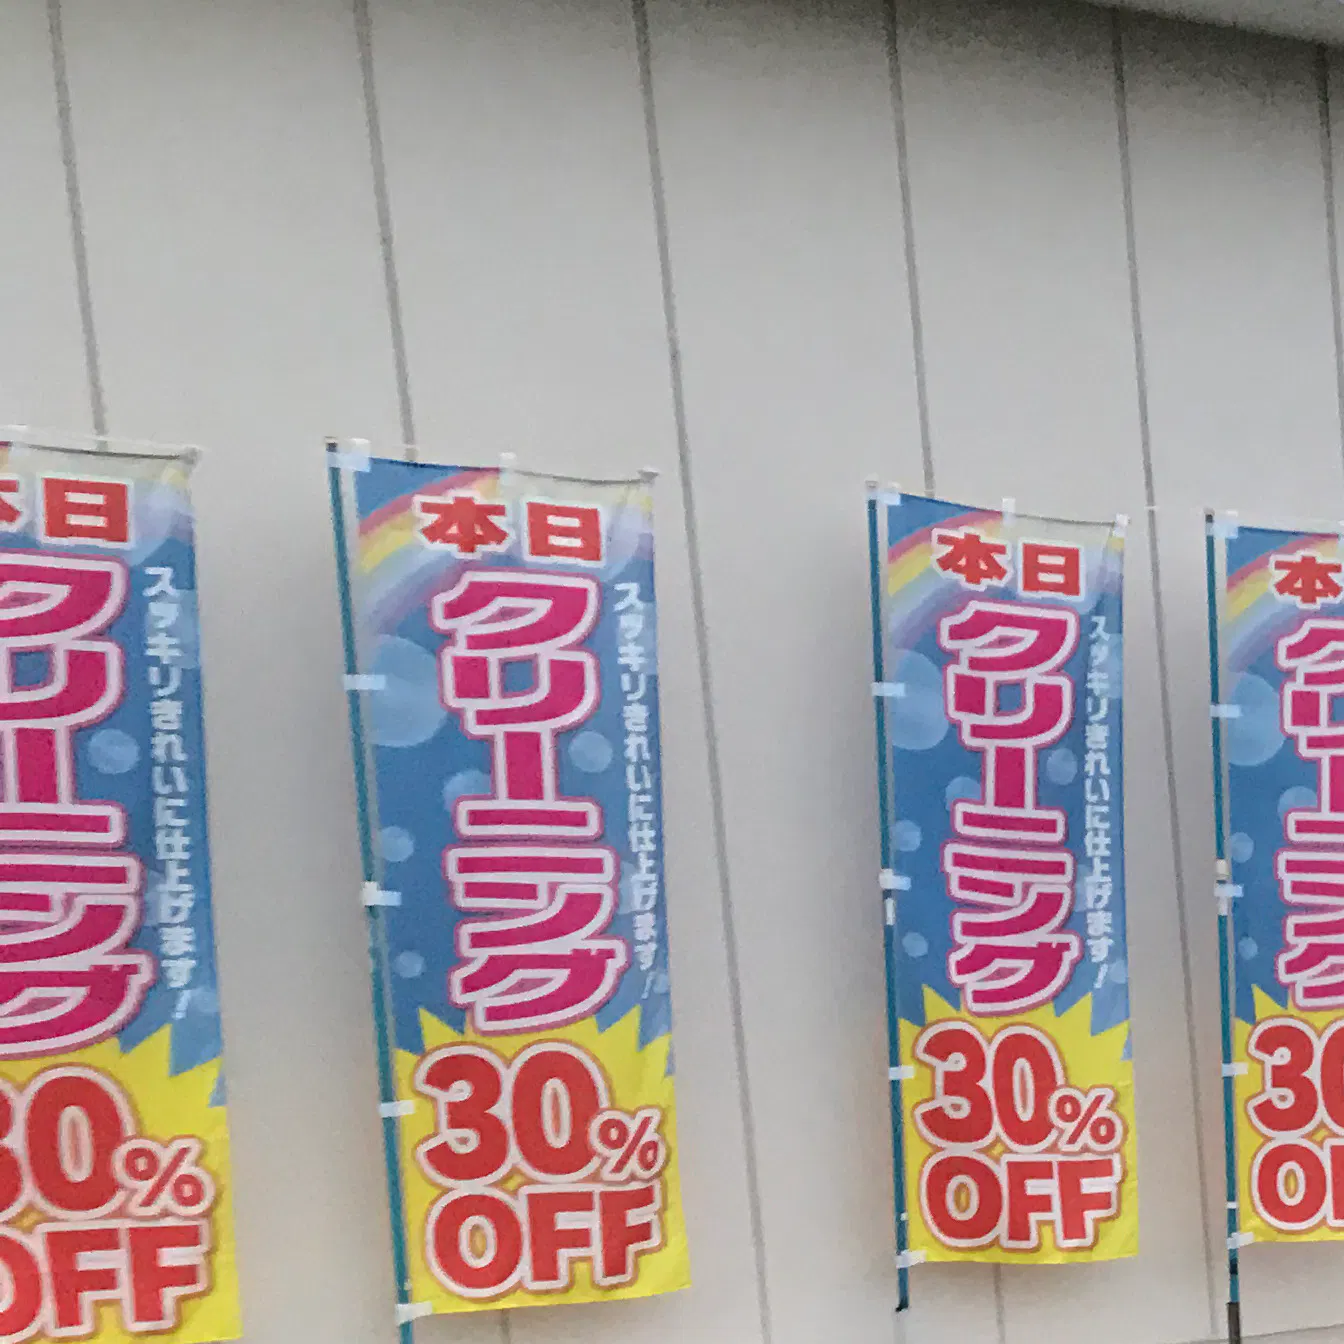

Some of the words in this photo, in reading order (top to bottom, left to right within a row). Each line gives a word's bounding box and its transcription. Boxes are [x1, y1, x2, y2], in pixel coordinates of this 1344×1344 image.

[0, 477, 128, 543] 日
[420, 496, 601, 562] 本日
[936, 532, 1080, 596] 本日
[432, 572, 630, 1032] クリーニング
[938, 601, 1080, 1013] クリーニング
[0, 1074, 203, 1213] 0%
[423, 1043, 659, 1181] 30%
[920, 1027, 1116, 1151] 30%
[433, 1184, 655, 1290] OFF
[924, 1154, 1114, 1242] OFF
